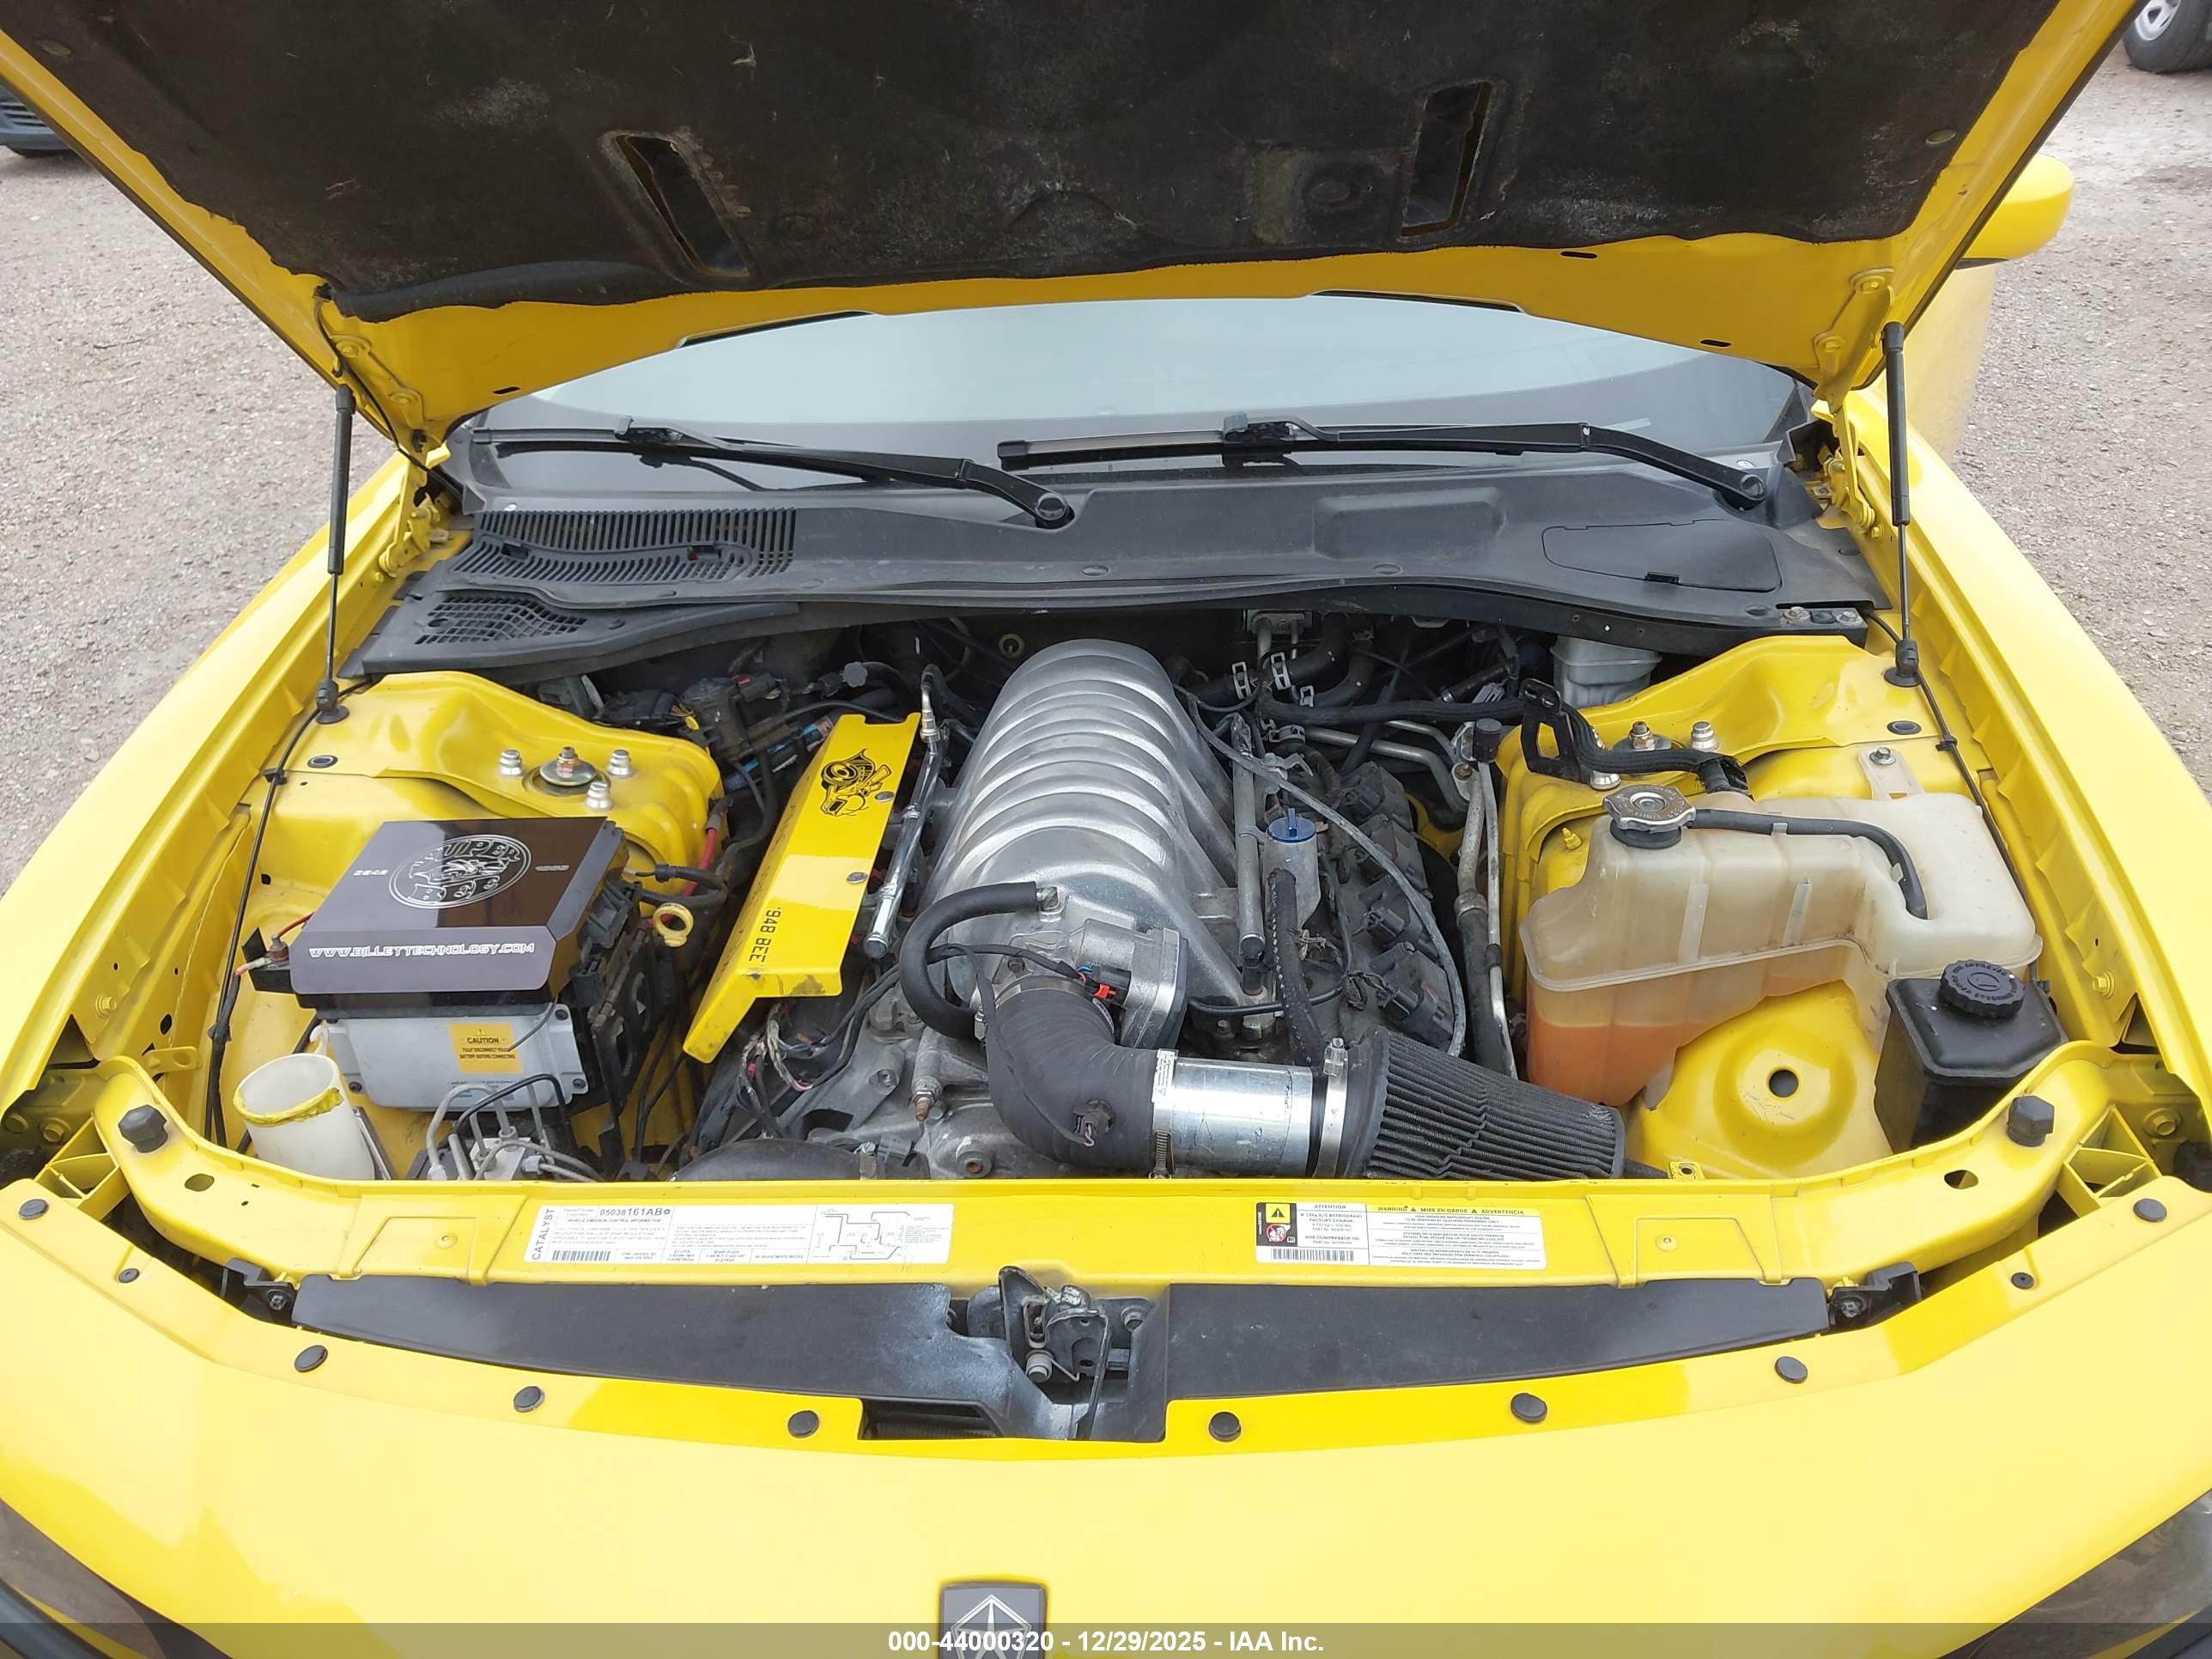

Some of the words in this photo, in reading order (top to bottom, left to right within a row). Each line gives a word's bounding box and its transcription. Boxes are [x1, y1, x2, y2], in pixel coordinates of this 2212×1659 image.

[308, 943, 535, 958] WWW.BILLETTECHNOLOGY.COM
[748, 938, 772, 963] BEE
[599, 1207, 663, 1217] 05038161AB
[532, 1208, 556, 1261] CATALYST
